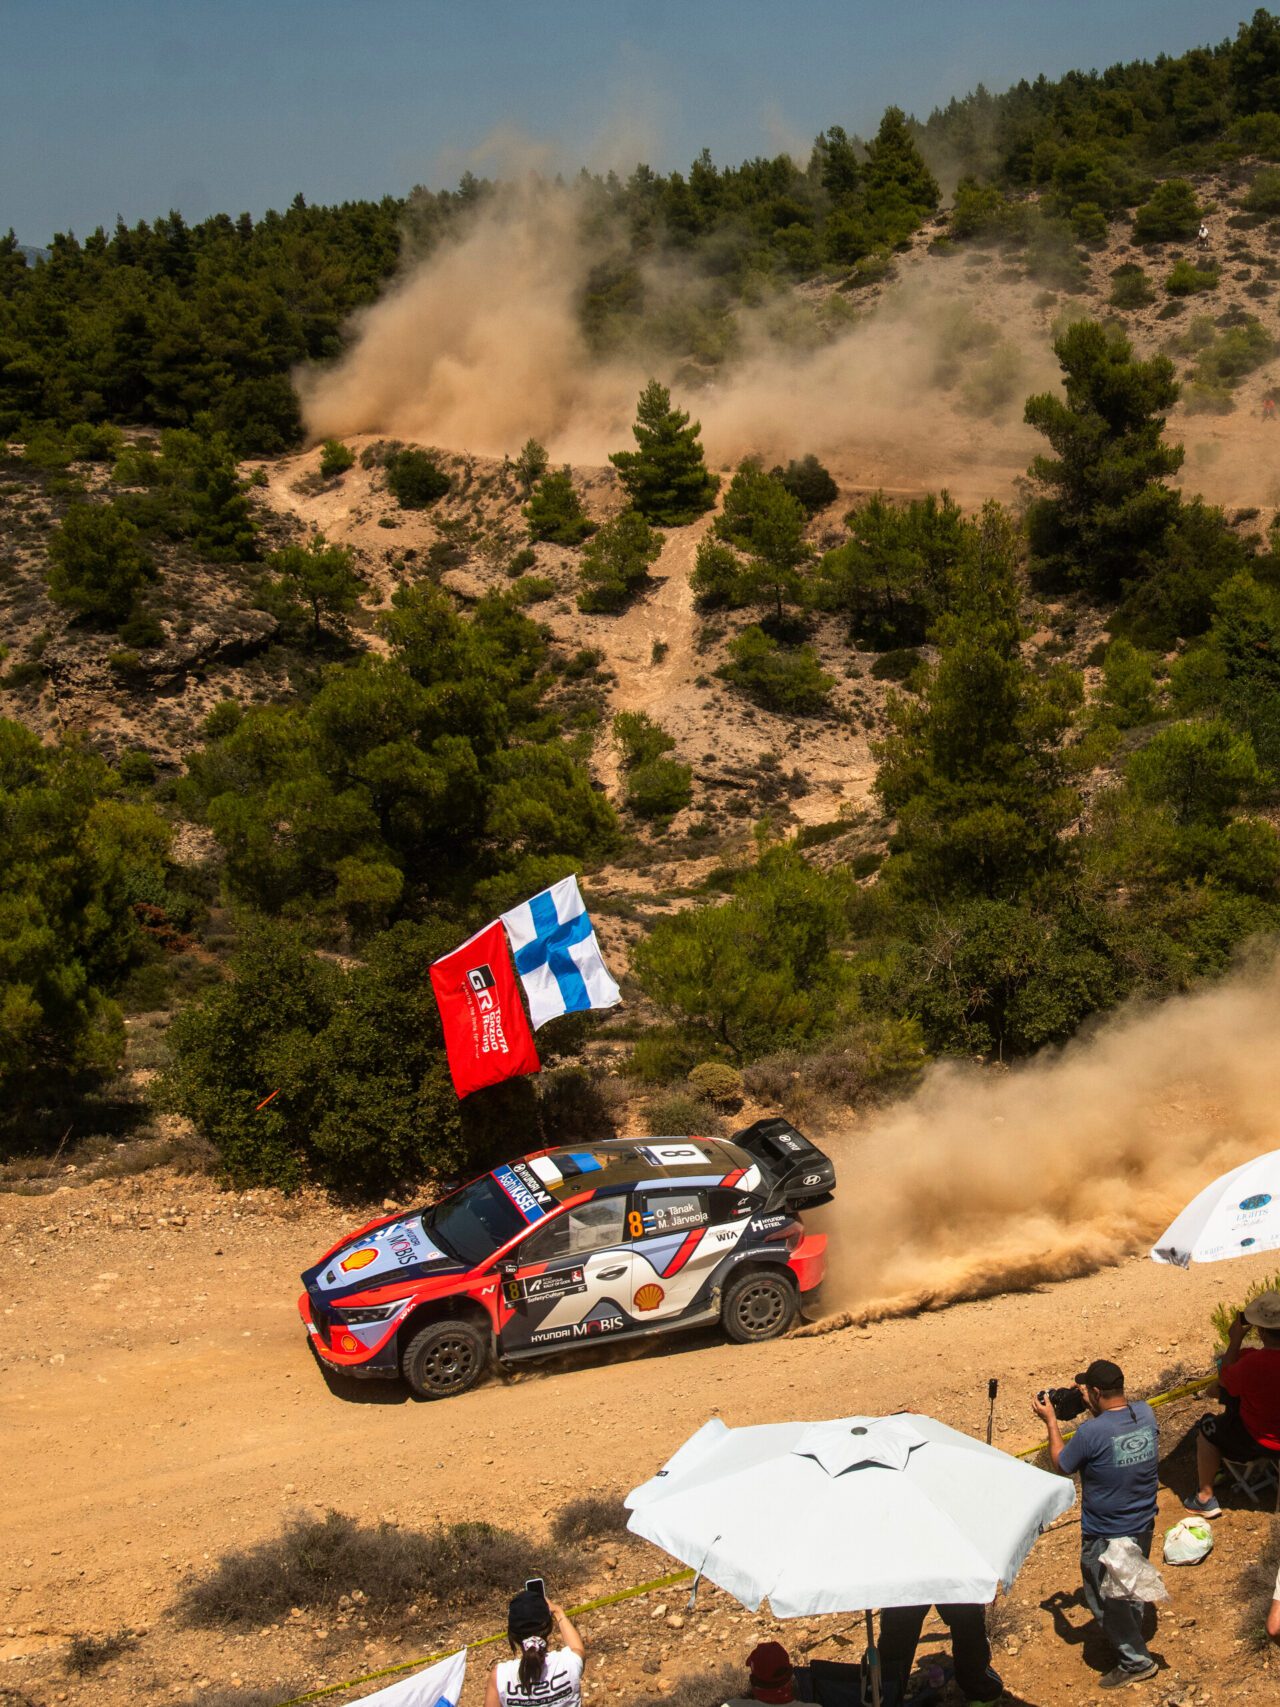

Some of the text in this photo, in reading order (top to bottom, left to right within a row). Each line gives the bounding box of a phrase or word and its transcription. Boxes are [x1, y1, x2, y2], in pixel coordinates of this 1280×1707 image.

[468, 969, 494, 1012] GR
[489, 1011, 499, 1051] GAZOO
[495, 1006, 509, 1054] TOYOTA
[628, 1210, 644, 1237] 8
[656, 1208, 667, 1218] O.
[658, 1219, 670, 1230] M.
[764, 1221, 782, 1229] STEEL
[387, 1234, 418, 1265] MOBIS
[509, 1282, 520, 1299] 8
[531, 1316, 624, 1343] HYUNDAI MOBIS
